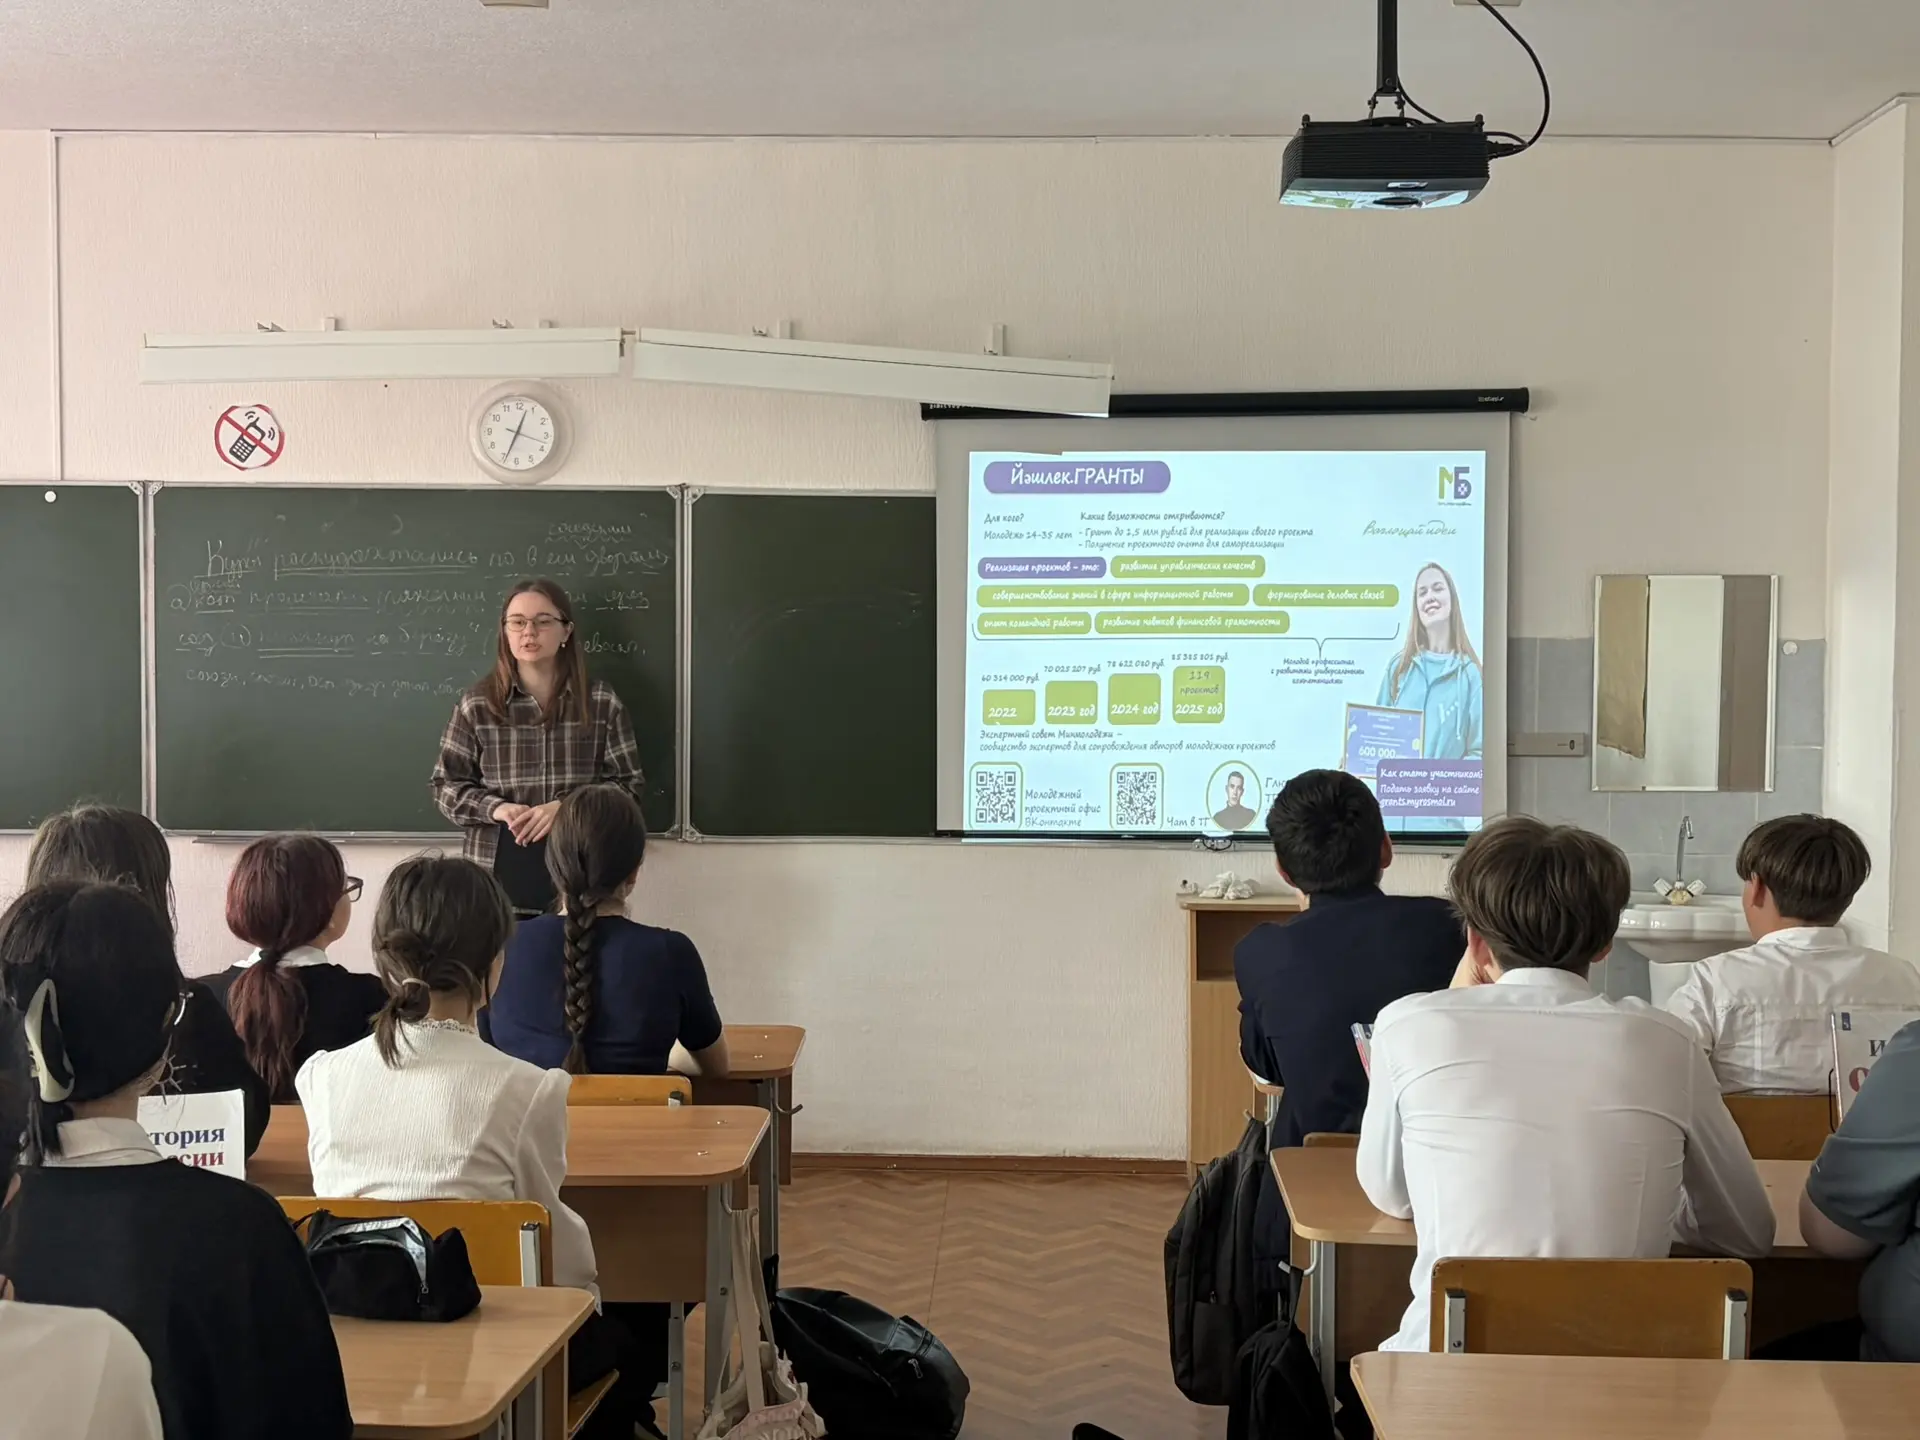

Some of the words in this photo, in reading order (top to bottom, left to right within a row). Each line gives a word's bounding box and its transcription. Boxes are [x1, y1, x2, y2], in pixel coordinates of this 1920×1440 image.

[502, 404, 510, 412] 11
[516, 402, 524, 410] 12
[532, 406, 535, 414] 1
[492, 414, 500, 422] 10
[540, 417, 546, 425] 2
[544, 432, 549, 440] 3
[490, 441, 496, 449] 8
[501, 452, 506, 460] 7
[514, 457, 519, 465] 6
[528, 455, 534, 463] 5
[1011, 463, 1144, 485] Йәшлек.ГРАНТЫ
[984, 513, 1001, 524] Для
[1002, 513, 1024, 523] кого?
[1080, 512, 1105, 521] Какие
[1107, 511, 1160, 521] возможности
[1163, 511, 1225, 522] открываются?
[1055, 531, 1072, 539] лет
[1085, 528, 1112, 538] Грант
[1114, 527, 1124, 537] до
[1160, 527, 1187, 538] рублей
[1190, 526, 1203, 536] для
[1205, 528, 1249, 538] реализации
[1251, 527, 1276, 536] своего
[1278, 528, 1313, 538] проекта
[1085, 540, 1125, 551] Получение
[1127, 540, 1175, 550] проектного
[1177, 540, 1204, 549] опыта
[1207, 539, 1219, 548] для
[1222, 540, 1285, 550] самореализации
[985, 563, 1029, 572] Реализация
[1031, 561, 1071, 574] проектов
[1081, 564, 1100, 572] это:
[1120, 560, 1158, 572] развитие
[1160, 560, 1220, 572] управленческих
[1223, 560, 1256, 570] качеств
[992, 590, 1069, 602] совершенствование
[1072, 590, 1098, 599] знаний
[1101, 590, 1106, 599] в
[1107, 589, 1131, 602] сфере
[1134, 589, 1200, 601] информационной
[1203, 589, 1234, 600] работы
[1267, 589, 1325, 602] формирование
[1327, 589, 1358, 600] деловых
[1360, 590, 1385, 600] связей
[984, 620, 1007, 628] опыт
[1009, 617, 1050, 628] командной
[1053, 617, 1084, 629] работы
[1103, 617, 1140, 628] развитие
[1177, 616, 1221, 628] финансовой
[1224, 617, 1281, 627] грамотности
[981, 674, 991, 682] 60
[1010, 674, 1025, 682] 000
[1180, 684, 1220, 697] проектов
[988, 707, 1017, 718] 2022
[1047, 706, 1076, 717] 2023
[1080, 704, 1096, 717] год
[1111, 704, 1140, 715] 2024
[1143, 701, 1159, 715] год
[1175, 704, 1204, 715] 2025
[1207, 702, 1223, 715] год
[980, 729, 1029, 741] Экспертный
[1032, 729, 1055, 739] совет
[980, 741, 1027, 752] сообщество
[1029, 741, 1071, 752] экспертов
[1073, 741, 1086, 750] для
[1088, 741, 1147, 753] сопровождения
[1150, 740, 1183, 753] авторов
[1236, 740, 1276, 753] проектов
[1380, 768, 1397, 778] Как
[1399, 770, 1427, 778] стать
[1025, 789, 1082, 800] Молодёжный
[1380, 783, 1412, 794] Подать
[1413, 783, 1440, 796] заявку
[1454, 785, 1480, 794] сайте
[1379, 796, 1456, 808] grants.myrosmol.ru
[1024, 804, 1076, 816] проектный
[1078, 804, 1101, 816] офис
[1025, 817, 1082, 827] ВКонтакте
[1167, 817, 1188, 827] Чат
[1190, 817, 1197, 827] в
[149, 1128, 225, 1150] тория
[167, 1151, 225, 1167] сии
